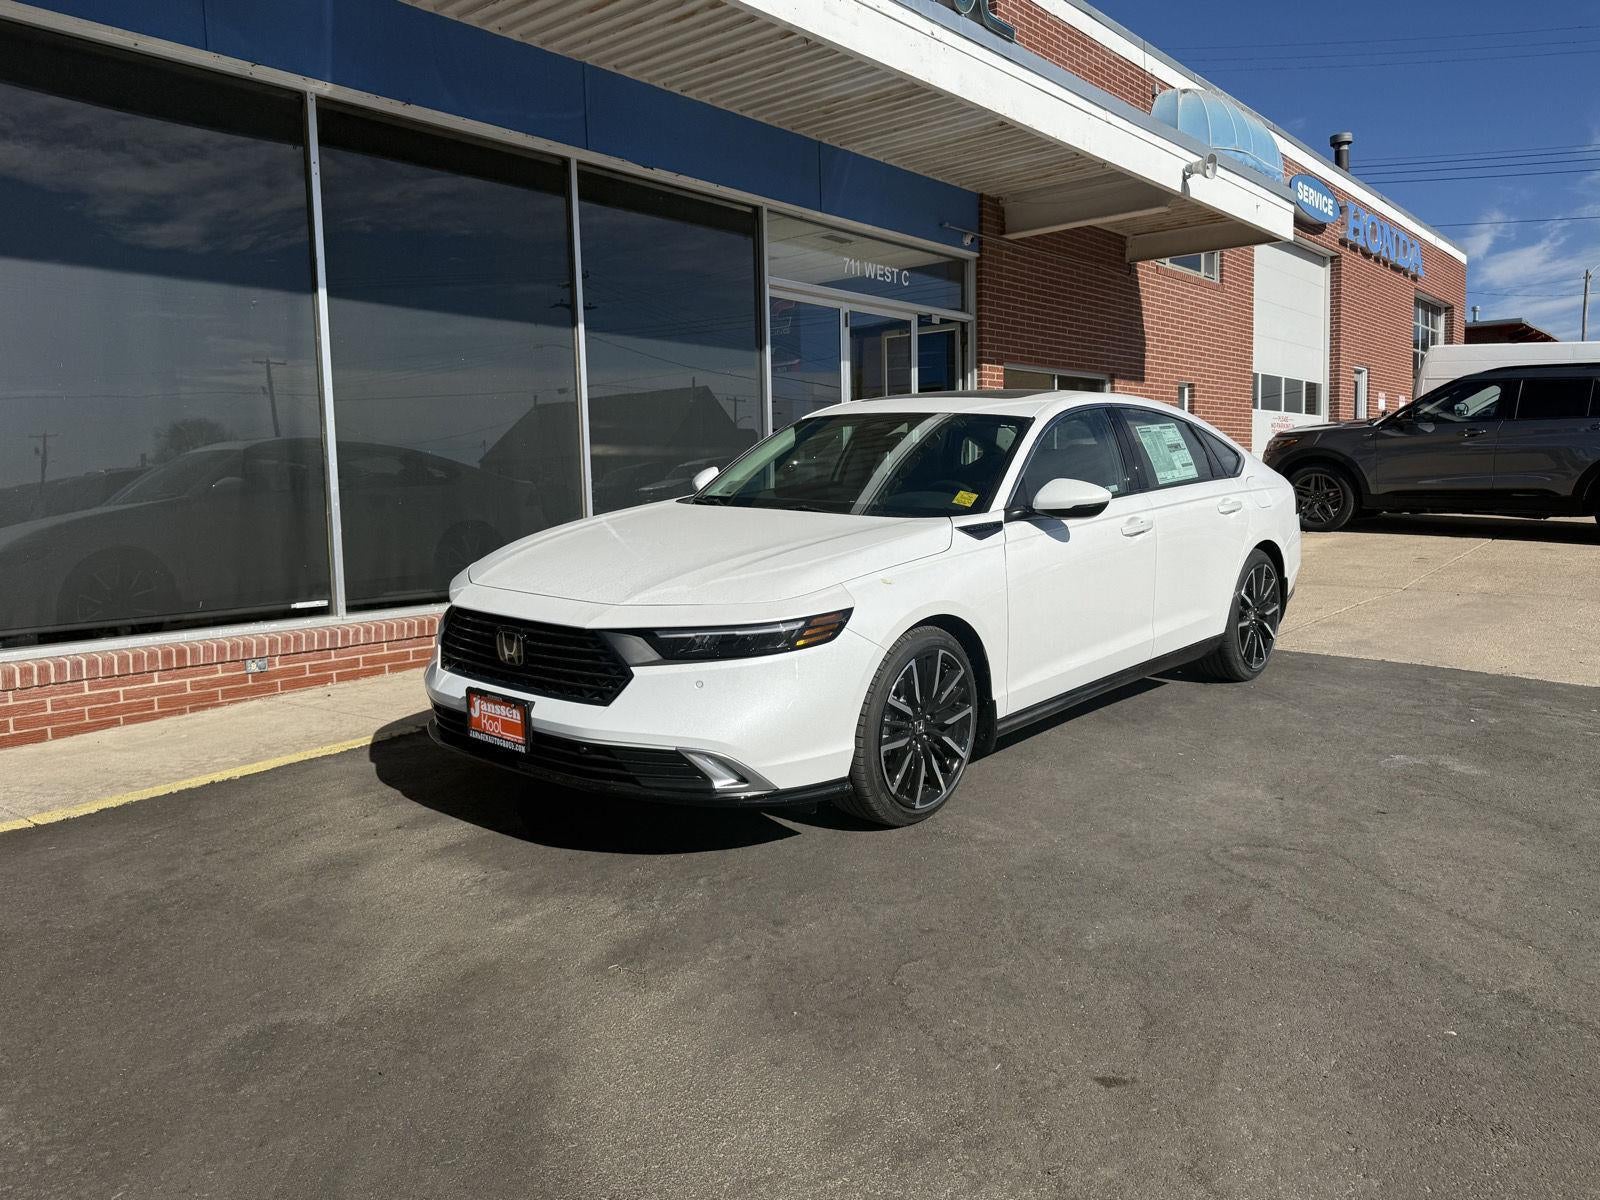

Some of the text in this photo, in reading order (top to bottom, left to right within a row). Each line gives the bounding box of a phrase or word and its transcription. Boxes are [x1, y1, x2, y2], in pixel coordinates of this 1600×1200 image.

[1297, 181, 1334, 217] SERVICE
[1346, 201, 1425, 277] HONDA
[843, 257, 910, 287] 711 WEST C
[470, 695, 521, 720] Janssen
